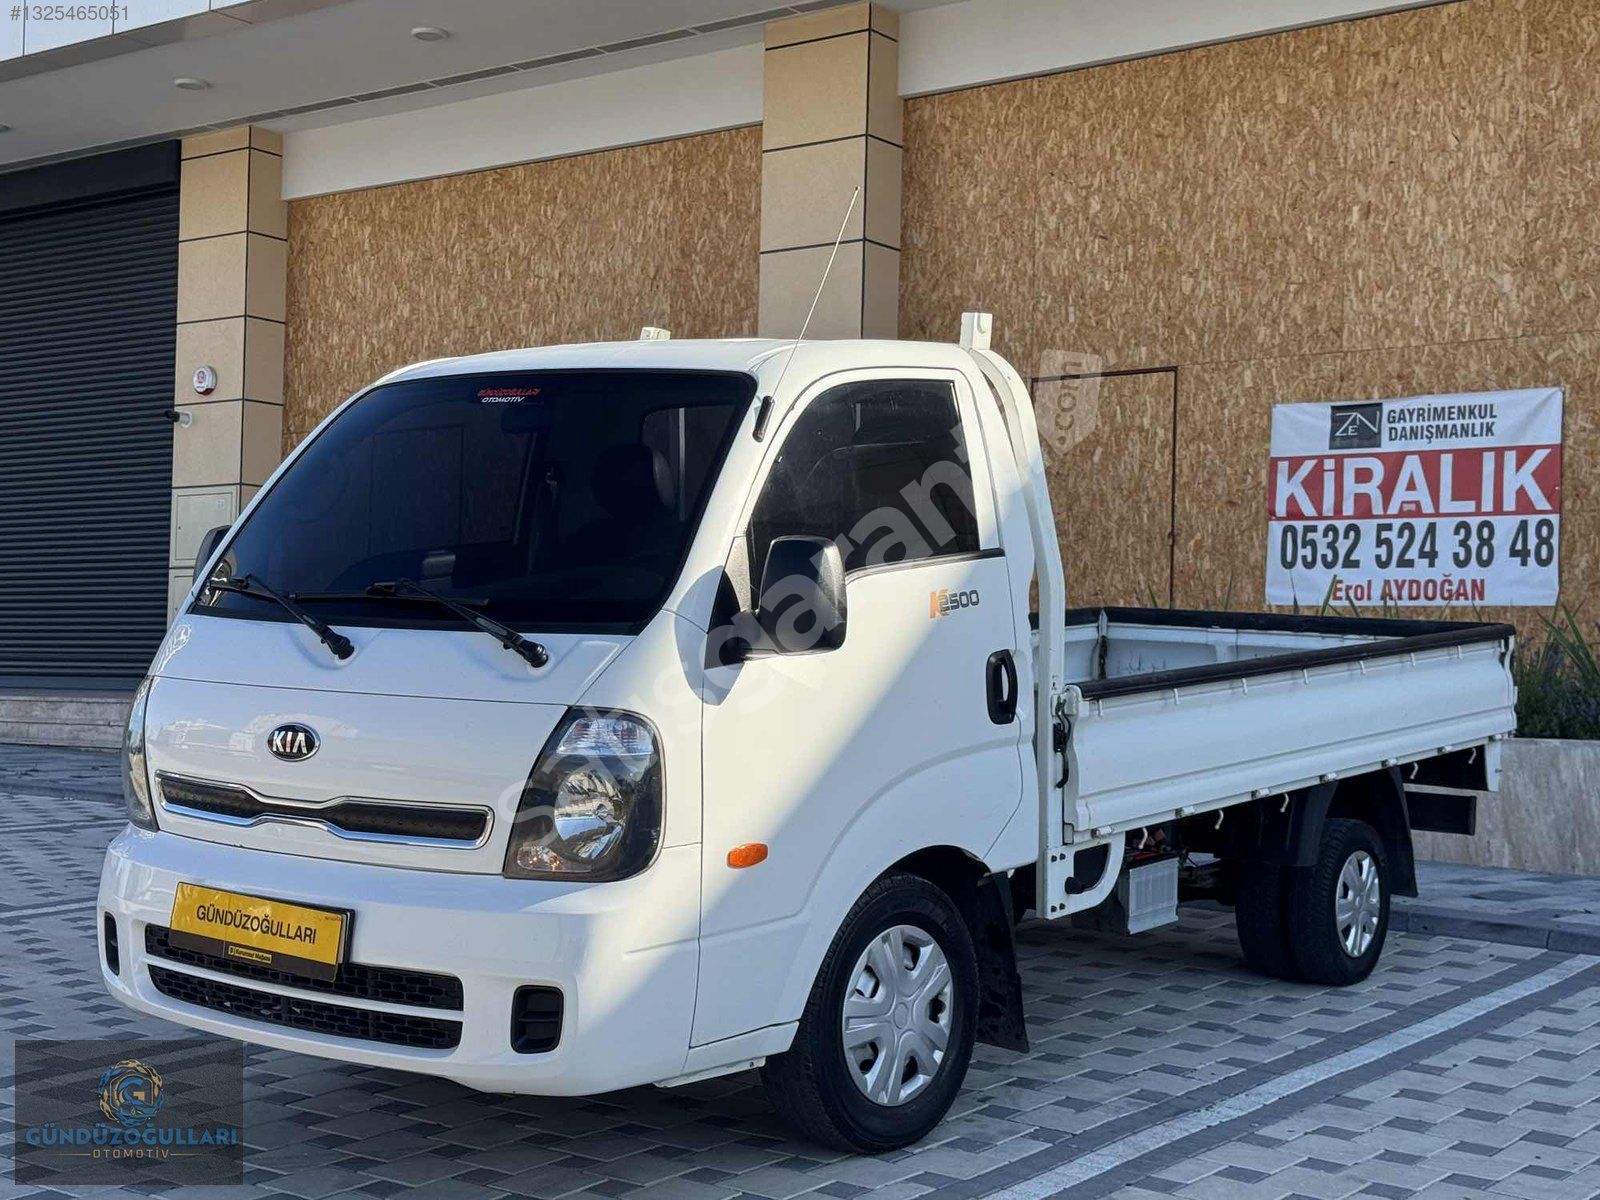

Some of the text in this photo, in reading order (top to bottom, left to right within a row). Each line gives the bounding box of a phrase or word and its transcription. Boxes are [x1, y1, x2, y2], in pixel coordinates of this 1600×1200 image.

[1387, 403, 1497, 424] GAYRİMENKUL
[1388, 421, 1495, 444] DANIŞMANLIK
[1280, 518, 1554, 570] 0532 524 38 48
[1332, 574, 1485, 601] Erol AYDOĞAN
[272, 730, 308, 754] KIA
[196, 904, 317, 945] GÜNDÜZOĞULLARI
